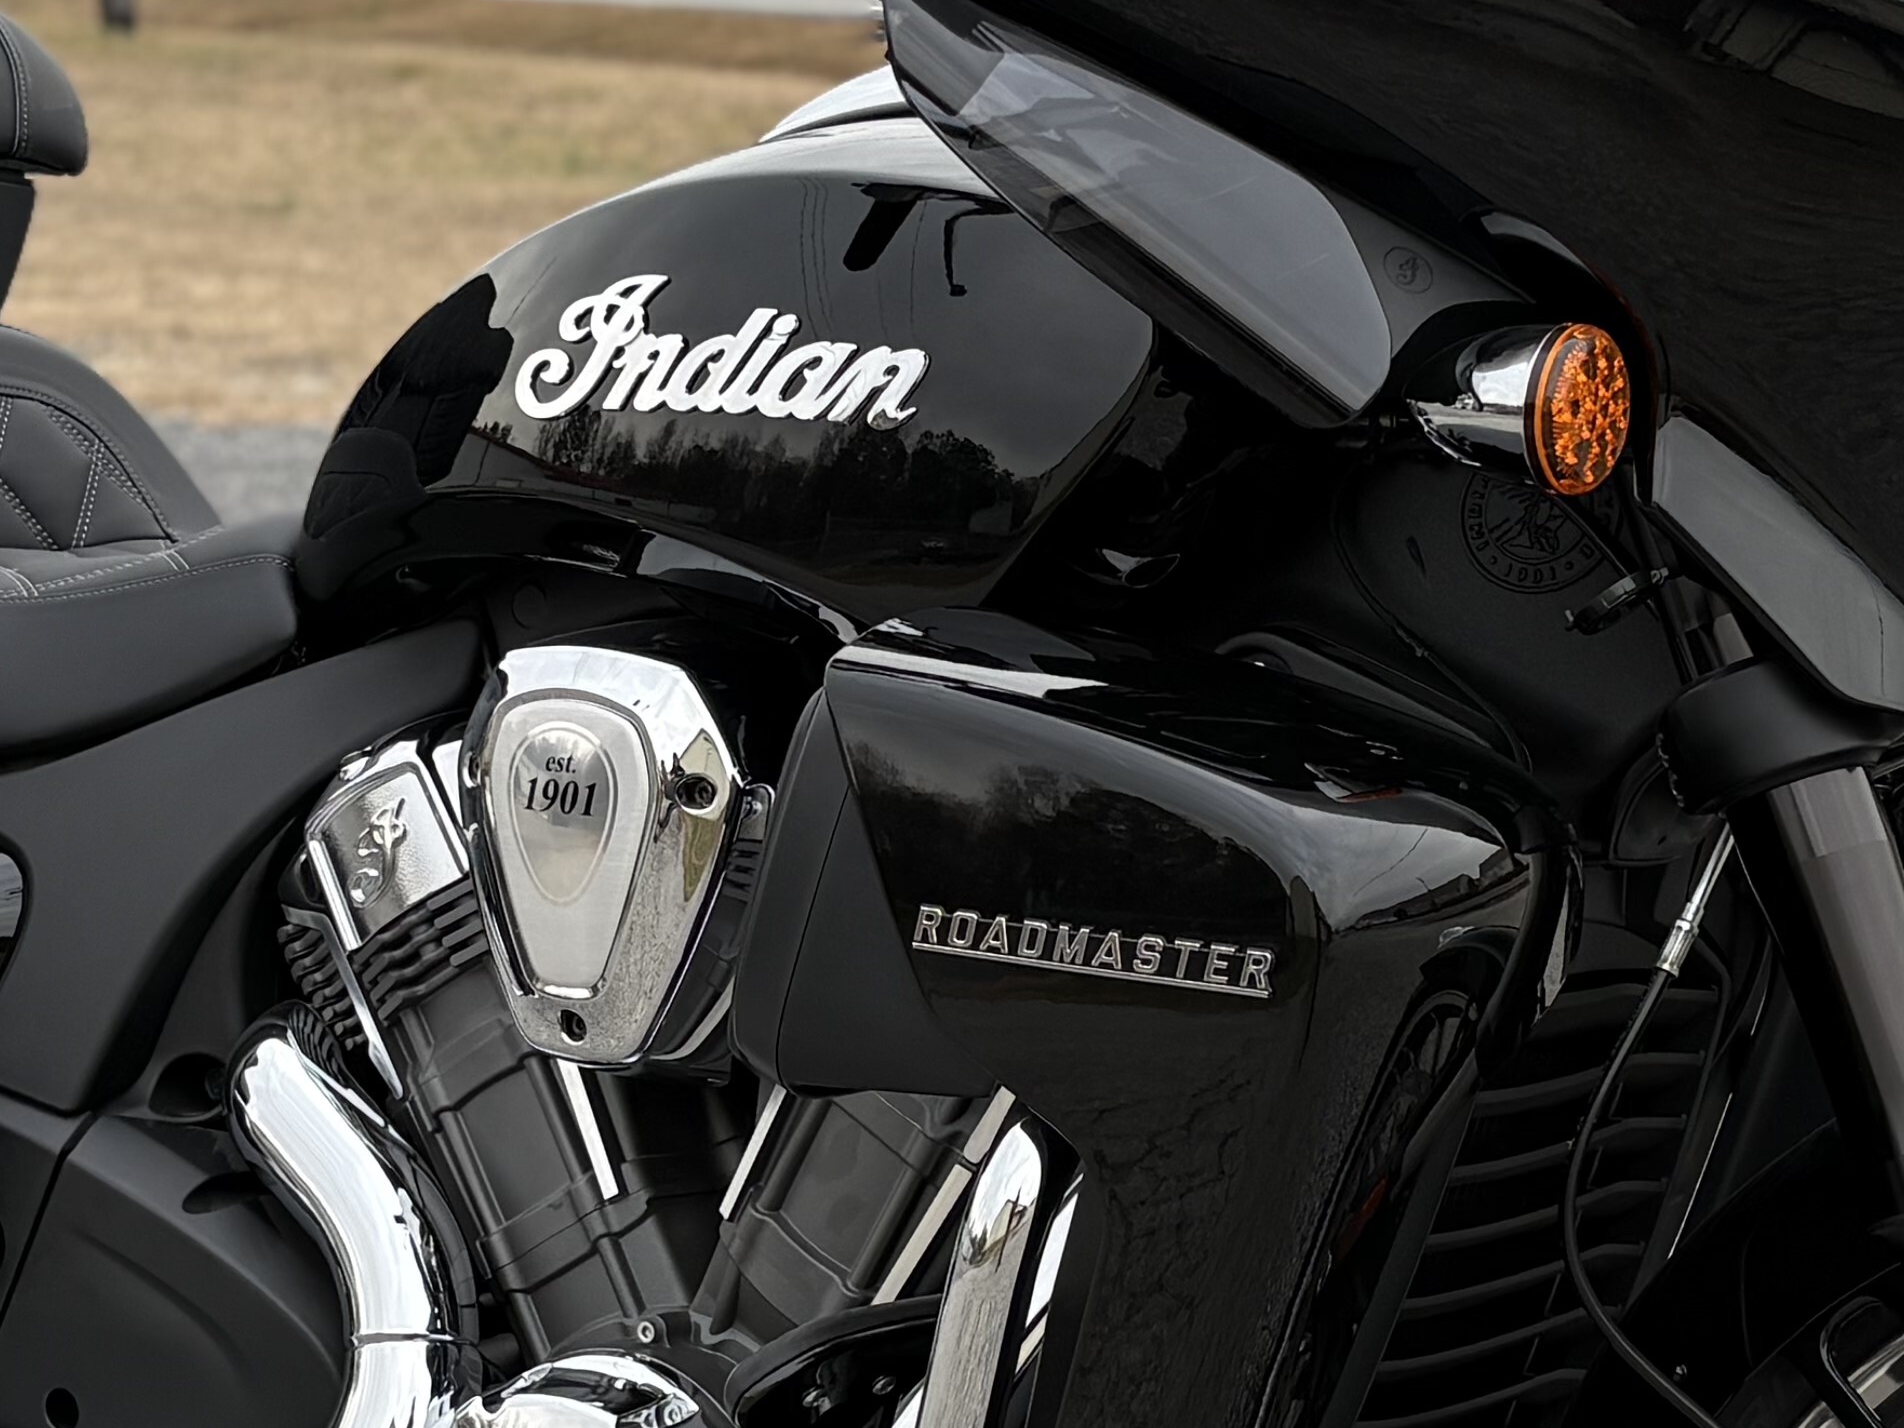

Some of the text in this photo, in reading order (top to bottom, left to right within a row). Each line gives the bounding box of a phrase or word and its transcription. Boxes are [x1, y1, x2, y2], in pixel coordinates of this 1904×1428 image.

[515, 273, 929, 431] Indian
[545, 753, 577, 775] est.
[523, 776, 598, 818] 1901
[913, 903, 1276, 992] ROADMASTER
